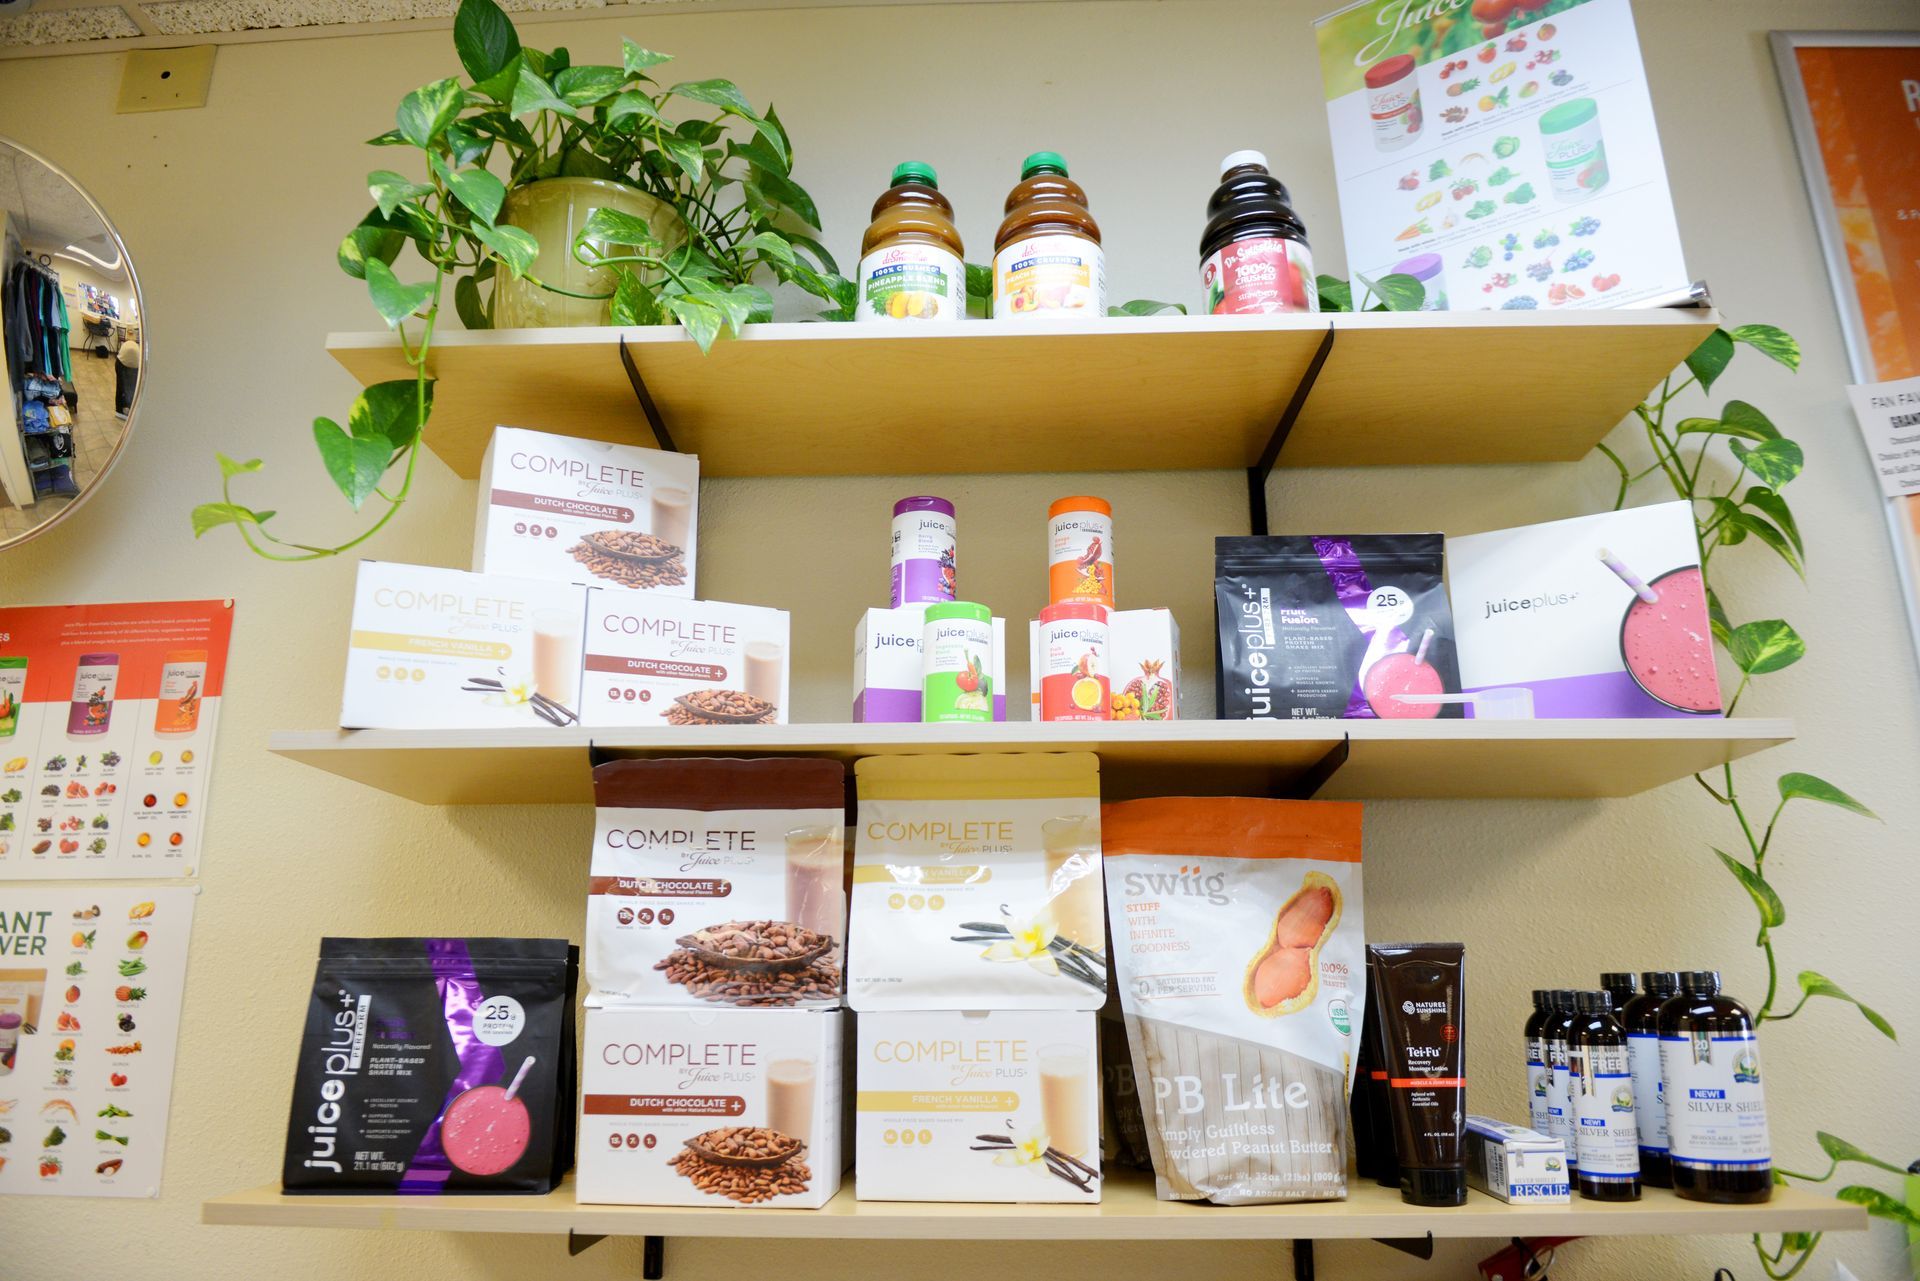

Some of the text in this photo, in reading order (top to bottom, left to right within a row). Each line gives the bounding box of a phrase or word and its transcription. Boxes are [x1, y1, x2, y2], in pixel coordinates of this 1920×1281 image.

[875, 266, 894, 277] 100%
[1014, 260, 1034, 271] 100%
[1235, 263, 1276, 278] 100%
[868, 274, 946, 290] PINEAPPLE BLEND
[1235, 273, 1276, 286] CRUSHED
[1238, 289, 1278, 302] strawberry
[511, 452, 645, 488] COMPLETE
[576, 481, 614, 498] Juice
[534, 497, 618, 516] DUTCH CHOCOLATE
[375, 588, 526, 621] COMPLETE
[1281, 615, 1319, 624] Fusion
[603, 614, 737, 644] COMPLETE
[670, 639, 706, 658] Juice
[627, 660, 712, 675] DUTCH CHOCOLATE
[1291, 707, 1319, 716] NET WT.
[868, 821, 1013, 841] COMPLETE
[606, 829, 756, 851] COMPLETE
[679, 852, 721, 873] Juice
[619, 880, 714, 890] DUTCH CHOCOLATE
[1125, 865, 1229, 907] swiig
[1126, 902, 1160, 913] STUFF
[1128, 916, 1157, 926] WITH
[1129, 928, 1176, 940] INFINITE
[1131, 941, 1190, 954] GOODNESS
[1321, 962, 1349, 975] 100%
[1176, 984, 1217, 993] SERVING
[354, 1003, 367, 1059] PERFORM
[372, 1043, 432, 1052] Naturally Flavored
[874, 1040, 1028, 1063] COMPLETE
[602, 1043, 757, 1066] COMPLETE
[1591, 1059, 1622, 1070] FREE
[678, 1067, 721, 1090] Juice
[951, 1064, 993, 1087] Juice
[912, 1095, 999, 1104] FRENCH VANILLA
[1153, 1073, 1310, 1115] PB Lite
[1695, 1090, 1720, 1099] NEW!
[629, 1098, 727, 1107] DUTCH CHOCOLATE
[1688, 1103, 1733, 1113] SILVER
[1583, 1118, 1602, 1126] NEW!
[1159, 1124, 1275, 1144] imply Guiltless
[1579, 1127, 1609, 1137] SILVER
[355, 1151, 385, 1161] NET WT.
[1166, 1141, 1333, 1160] wdered Peanut Butter
[1515, 1184, 1567, 1196] RESCUE
